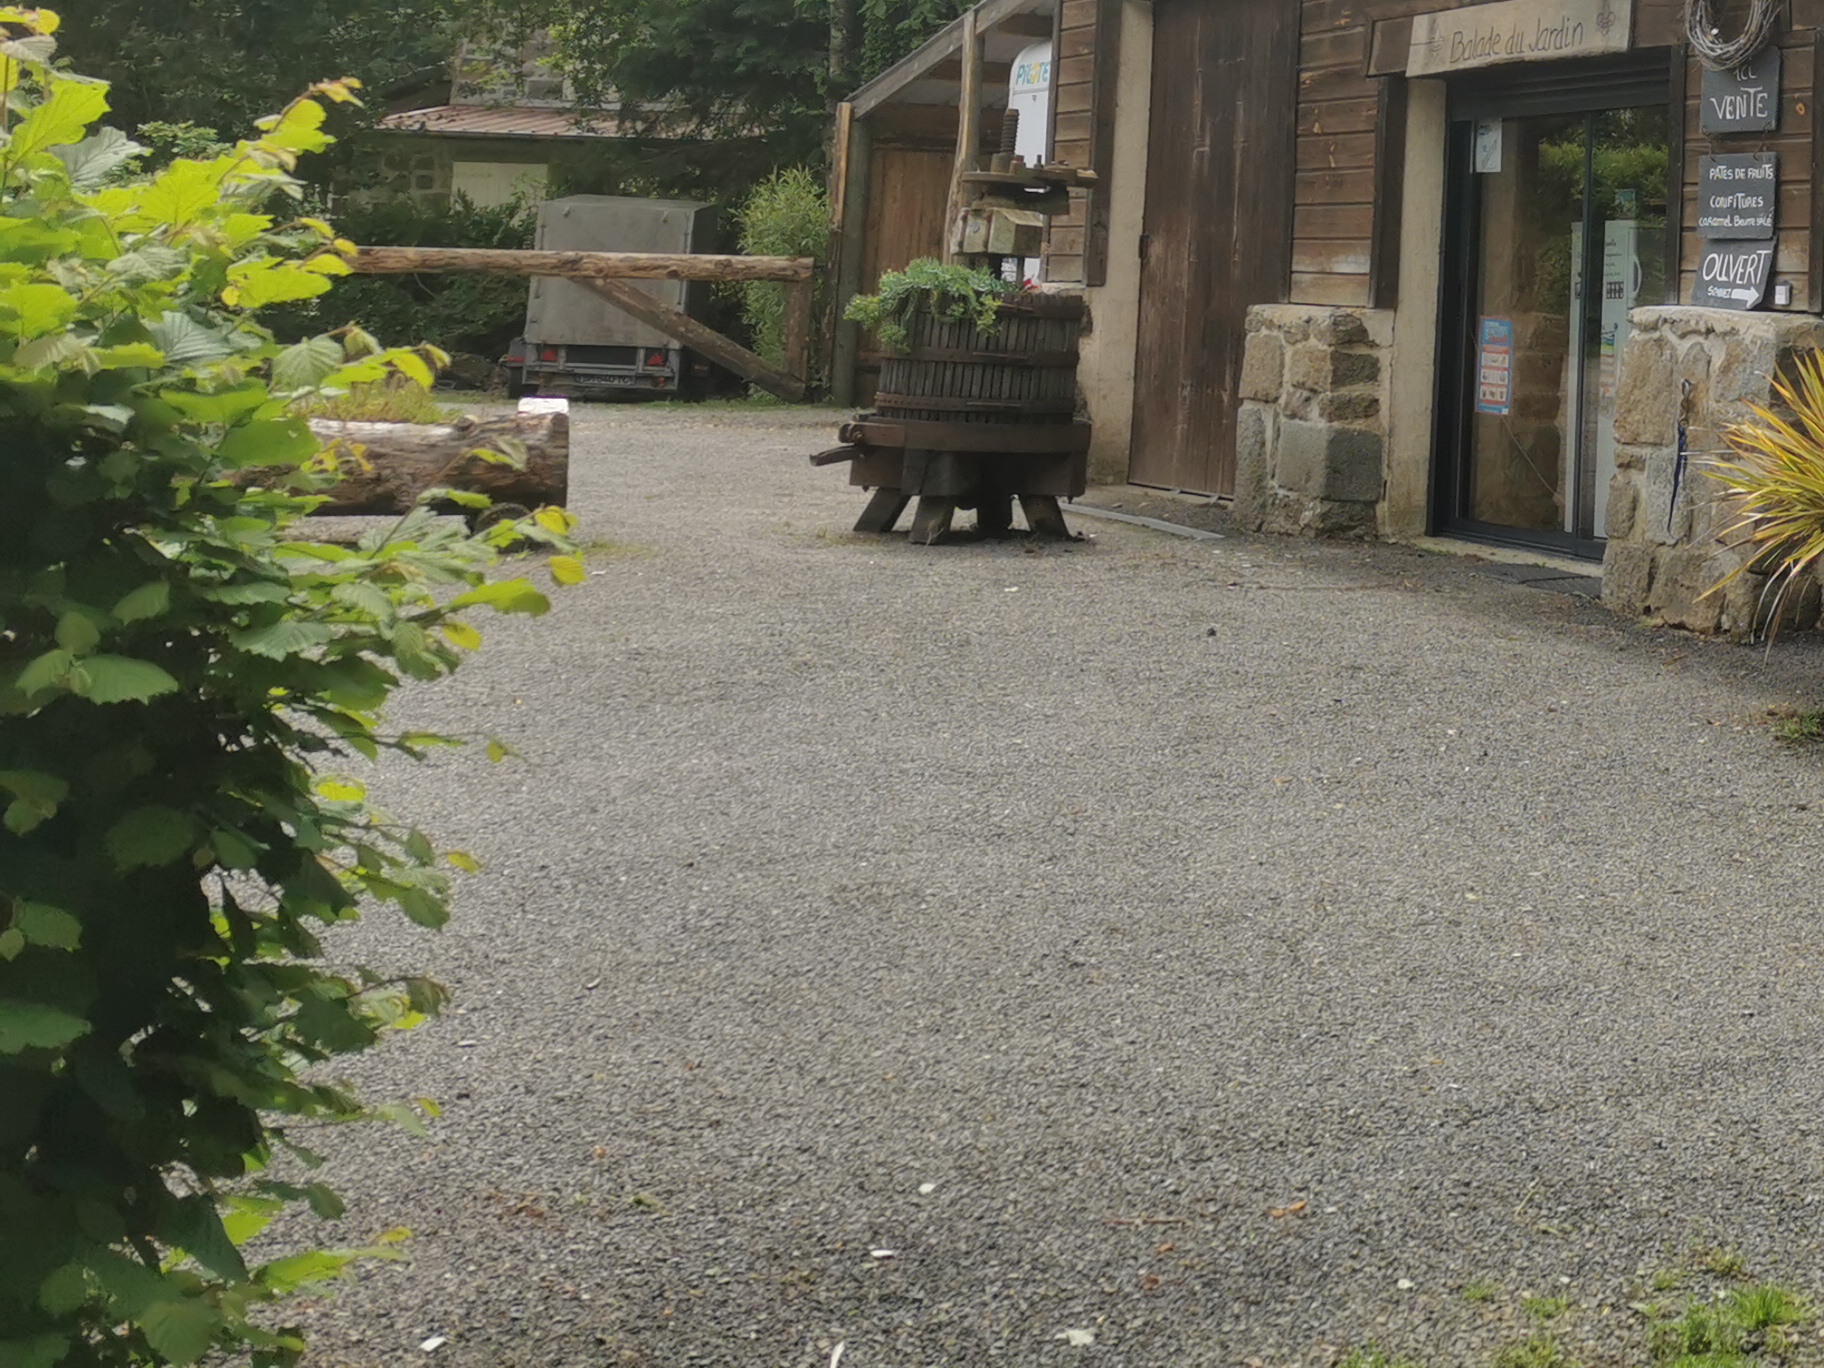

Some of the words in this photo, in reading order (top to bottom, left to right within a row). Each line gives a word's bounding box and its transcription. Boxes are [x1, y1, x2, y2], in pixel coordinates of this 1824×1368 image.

[1450, 26, 1500, 63] Balade
[1504, 22, 1525, 55] du
[1528, 14, 1584, 52] Jardin
[1709, 86, 1769, 120] VENTE
[1735, 168, 1746, 180] DE
[1747, 164, 1775, 180] FRUITS
[1709, 193, 1764, 209] CONFITURES
[1702, 250, 1772, 284] OUVERT
